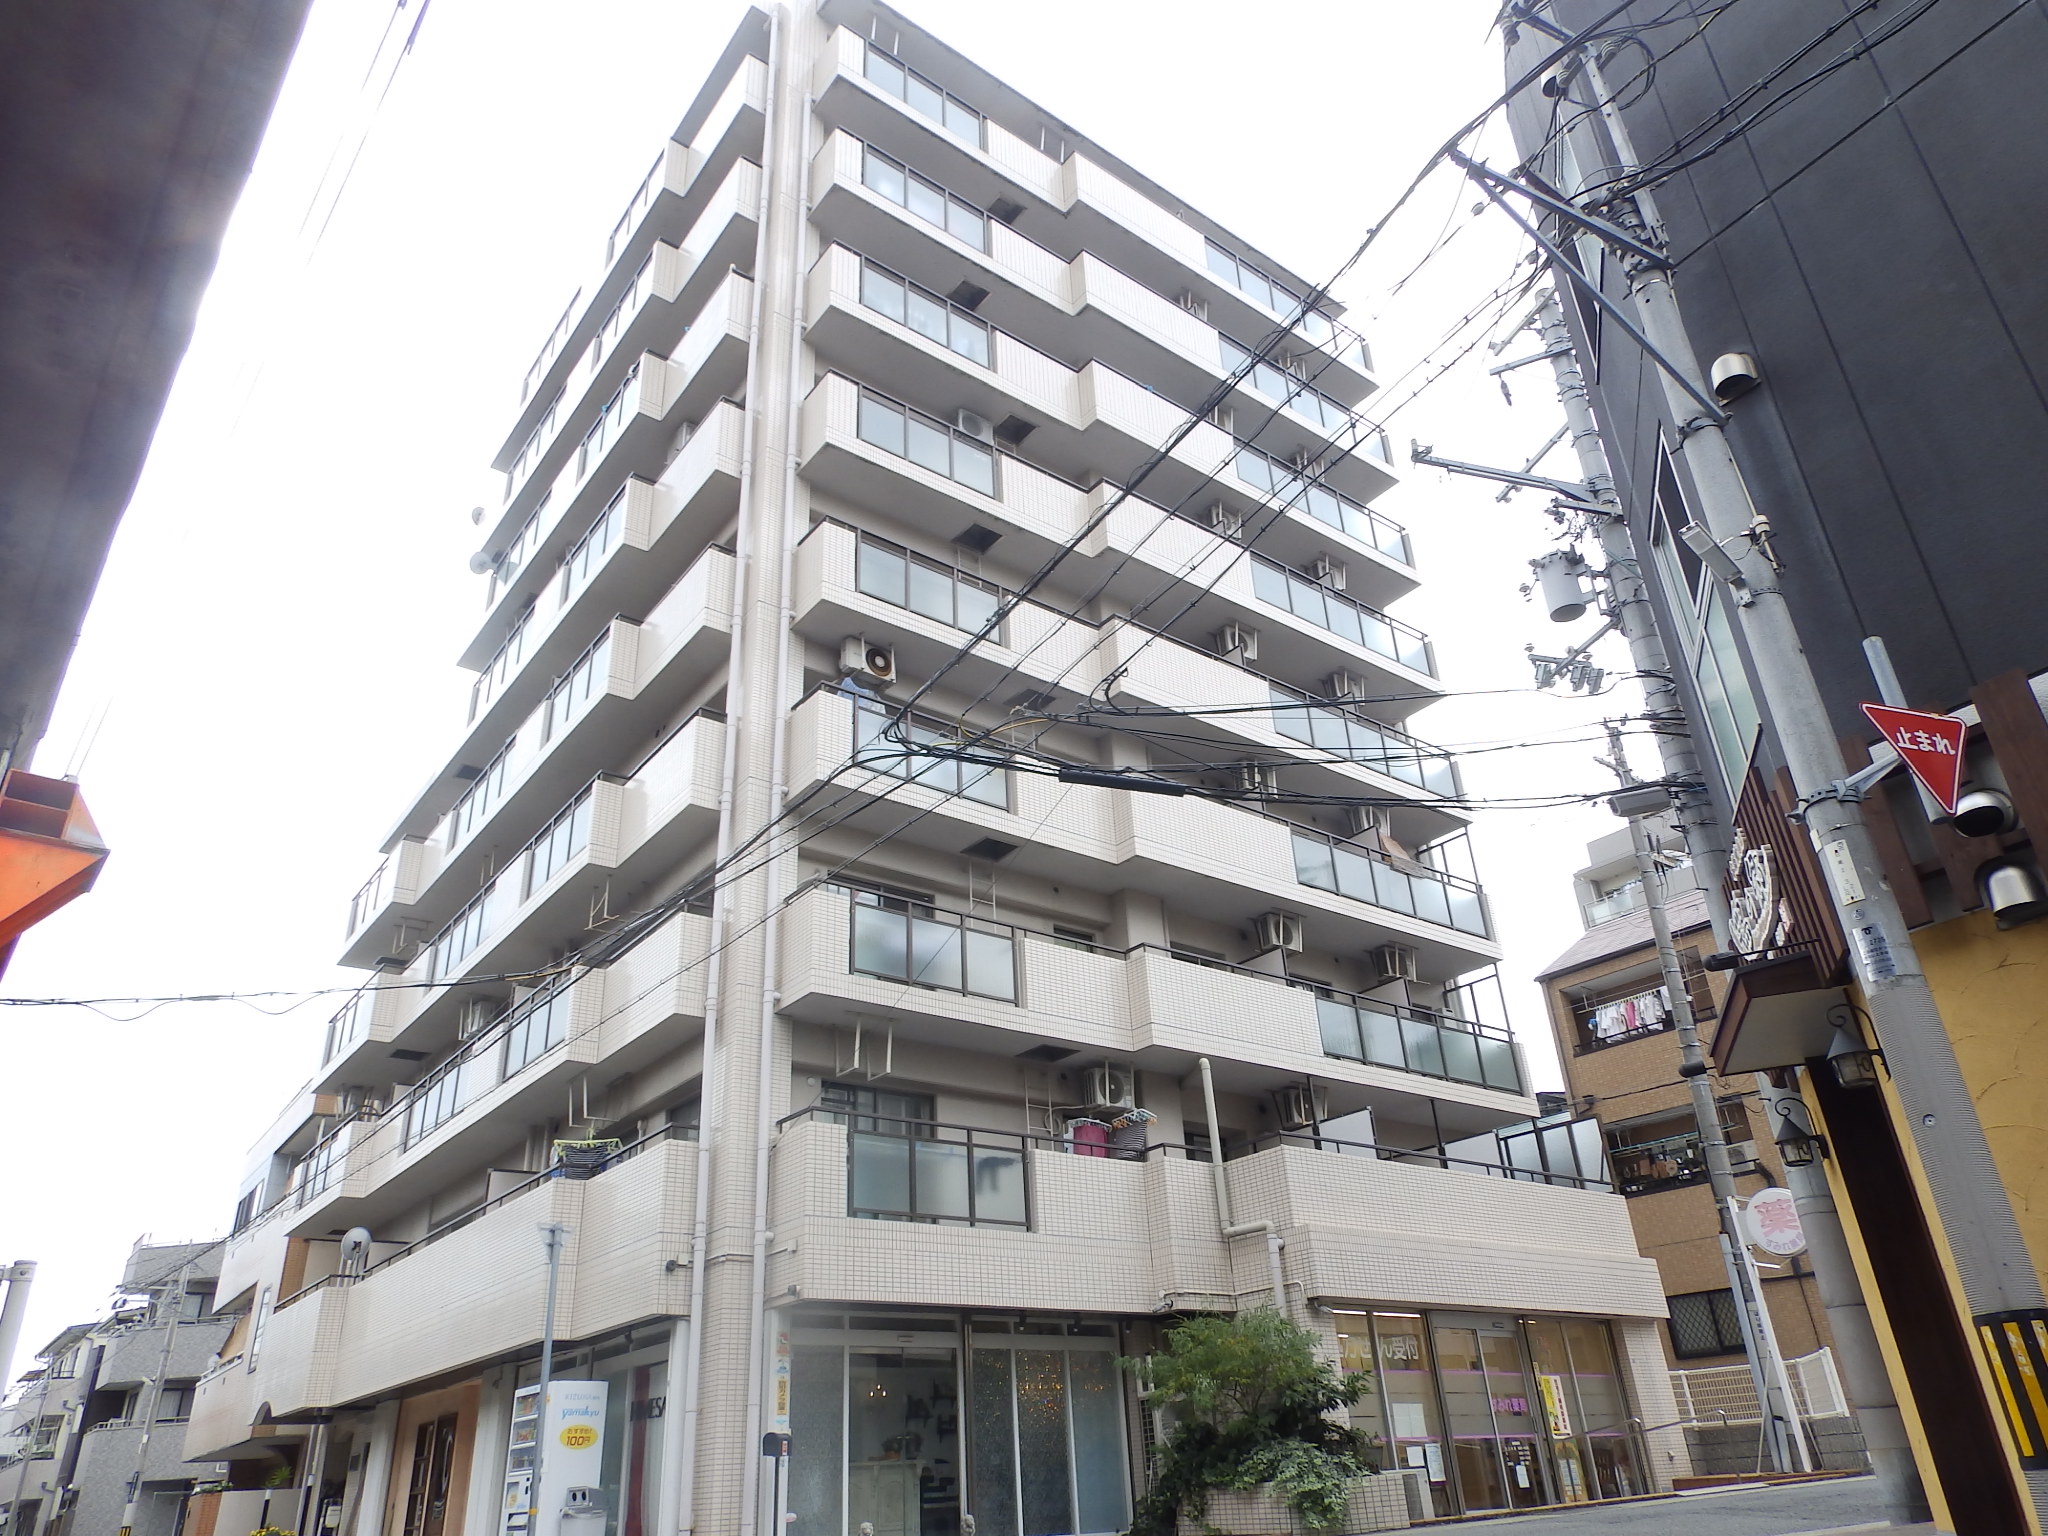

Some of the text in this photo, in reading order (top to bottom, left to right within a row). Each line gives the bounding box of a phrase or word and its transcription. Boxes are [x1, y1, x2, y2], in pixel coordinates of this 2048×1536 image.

[1896, 727, 1956, 755] 止まれ
[1754, 1198, 1800, 1237] 薬
[562, 1405, 600, 1420] yamakyu
[566, 1436, 591, 1447] 100円
